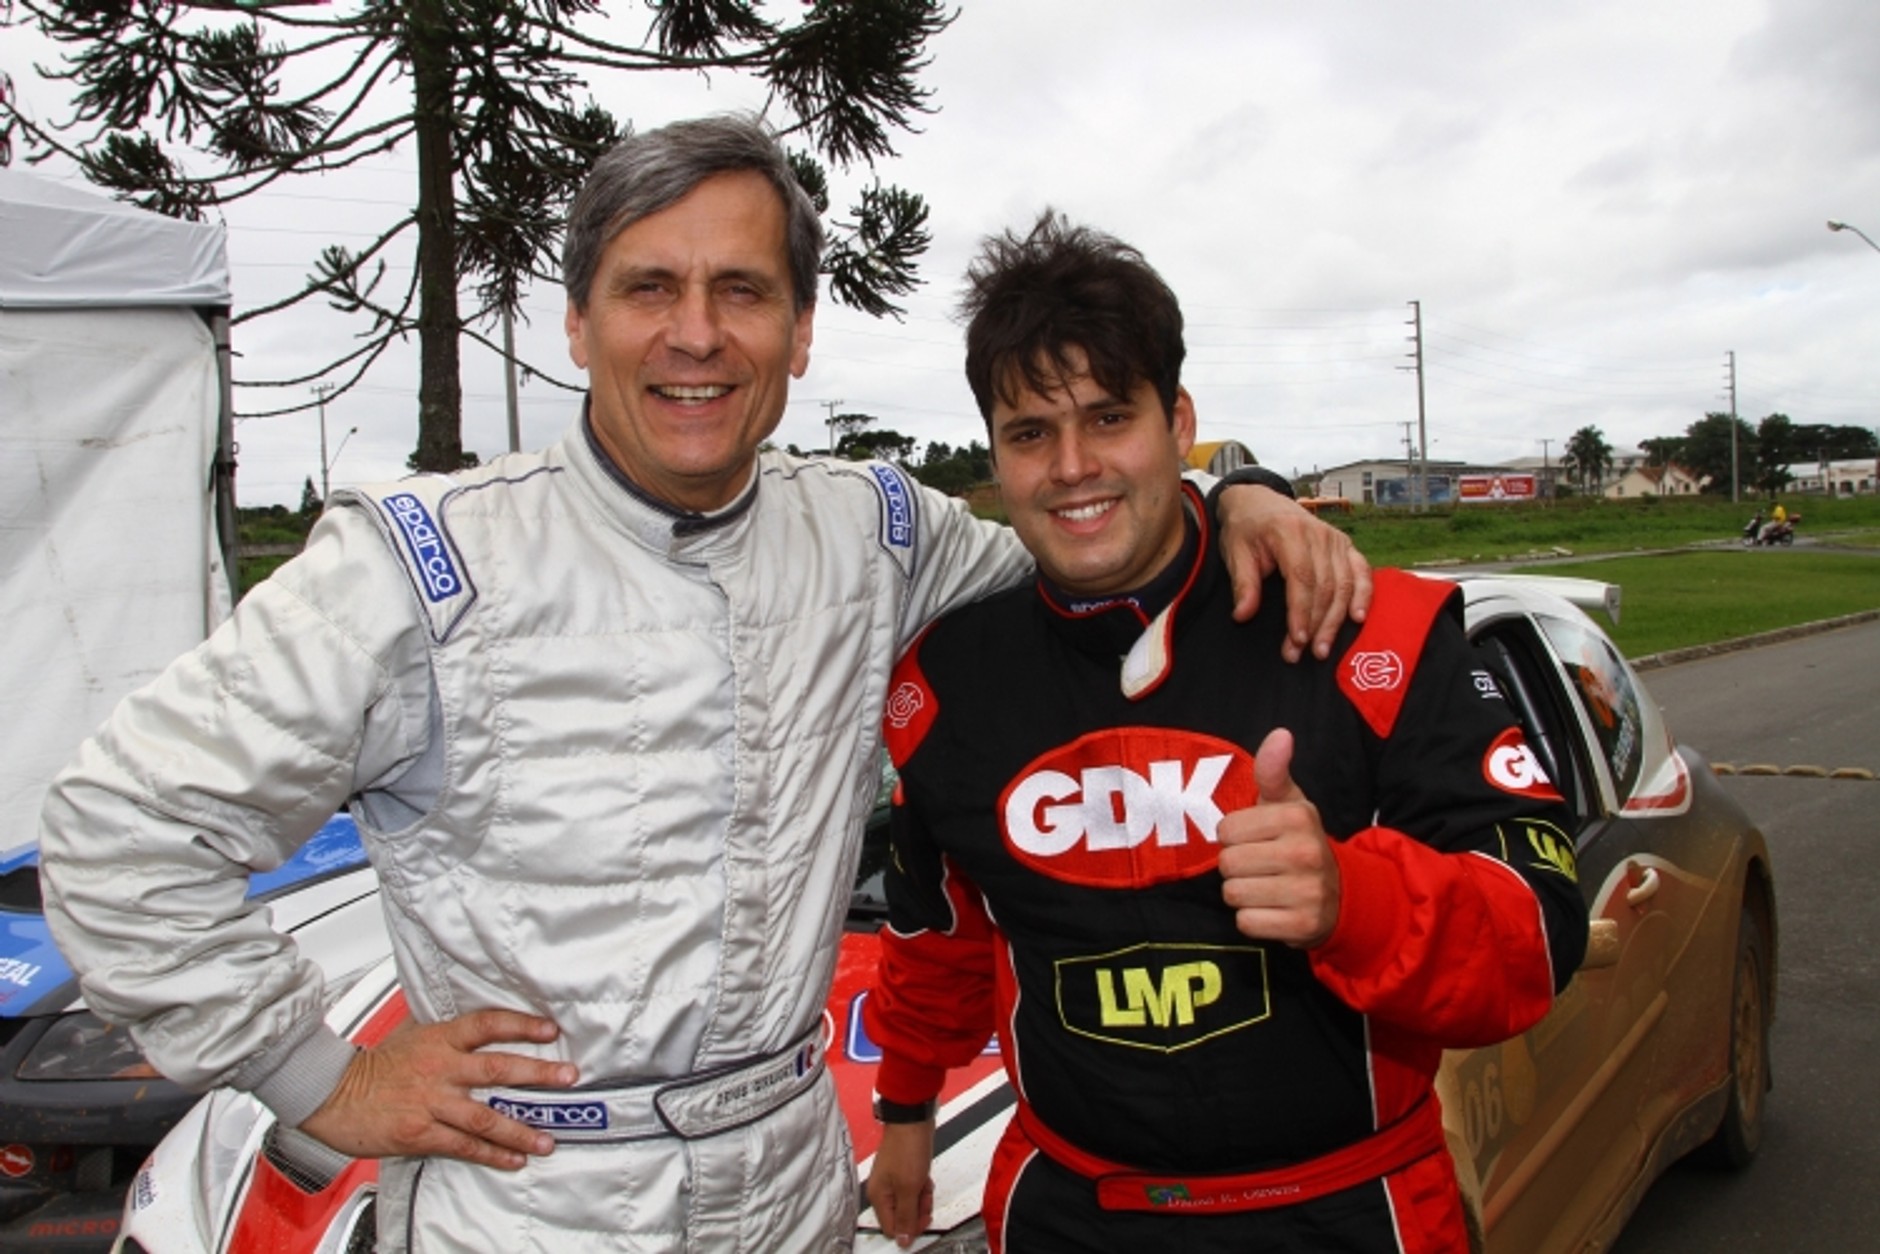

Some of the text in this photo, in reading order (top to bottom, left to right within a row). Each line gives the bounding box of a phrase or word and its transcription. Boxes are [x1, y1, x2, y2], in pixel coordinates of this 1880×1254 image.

[875, 466, 911, 541] sparco
[393, 496, 456, 596] sparco
[1005, 754, 1234, 857] GDK
[1096, 960, 1222, 1028] LMP
[493, 1101, 603, 1123] sparco
